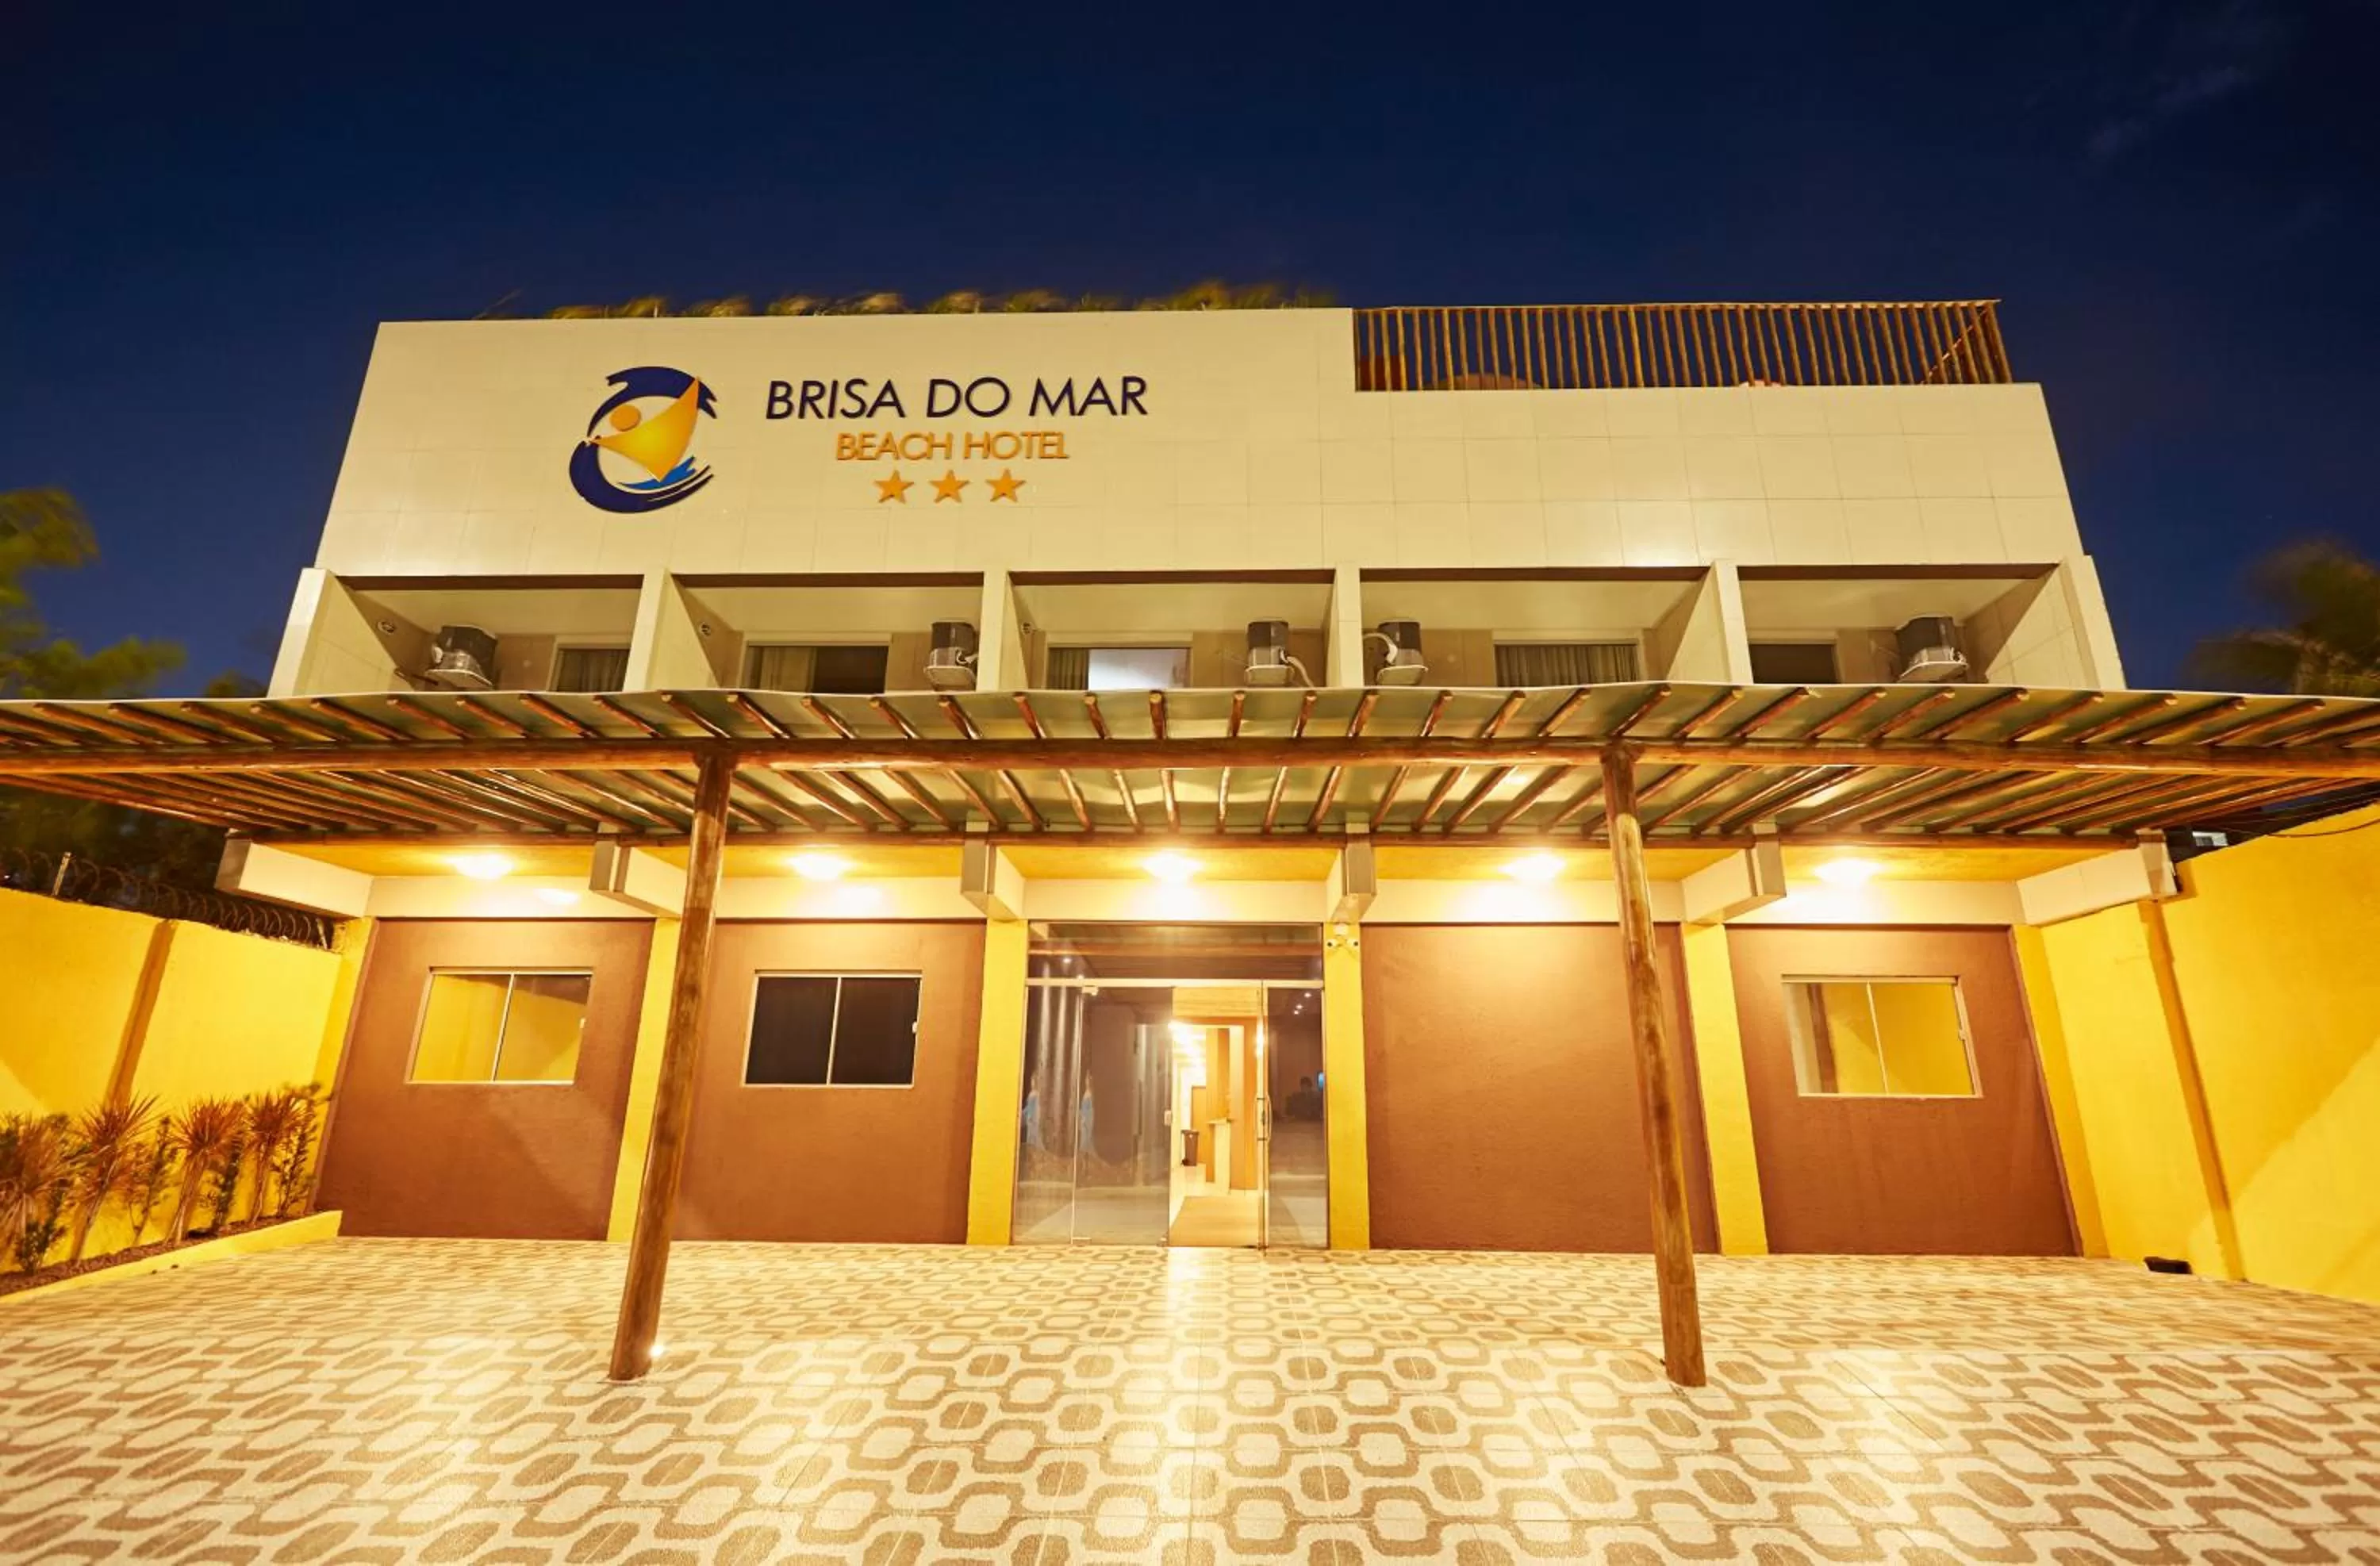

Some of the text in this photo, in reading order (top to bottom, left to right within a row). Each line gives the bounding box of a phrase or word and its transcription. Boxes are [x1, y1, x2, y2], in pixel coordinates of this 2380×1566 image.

[766, 376, 1149, 420] BRISA DO MAR
[835, 431, 1070, 461] BEACH HOTEL
